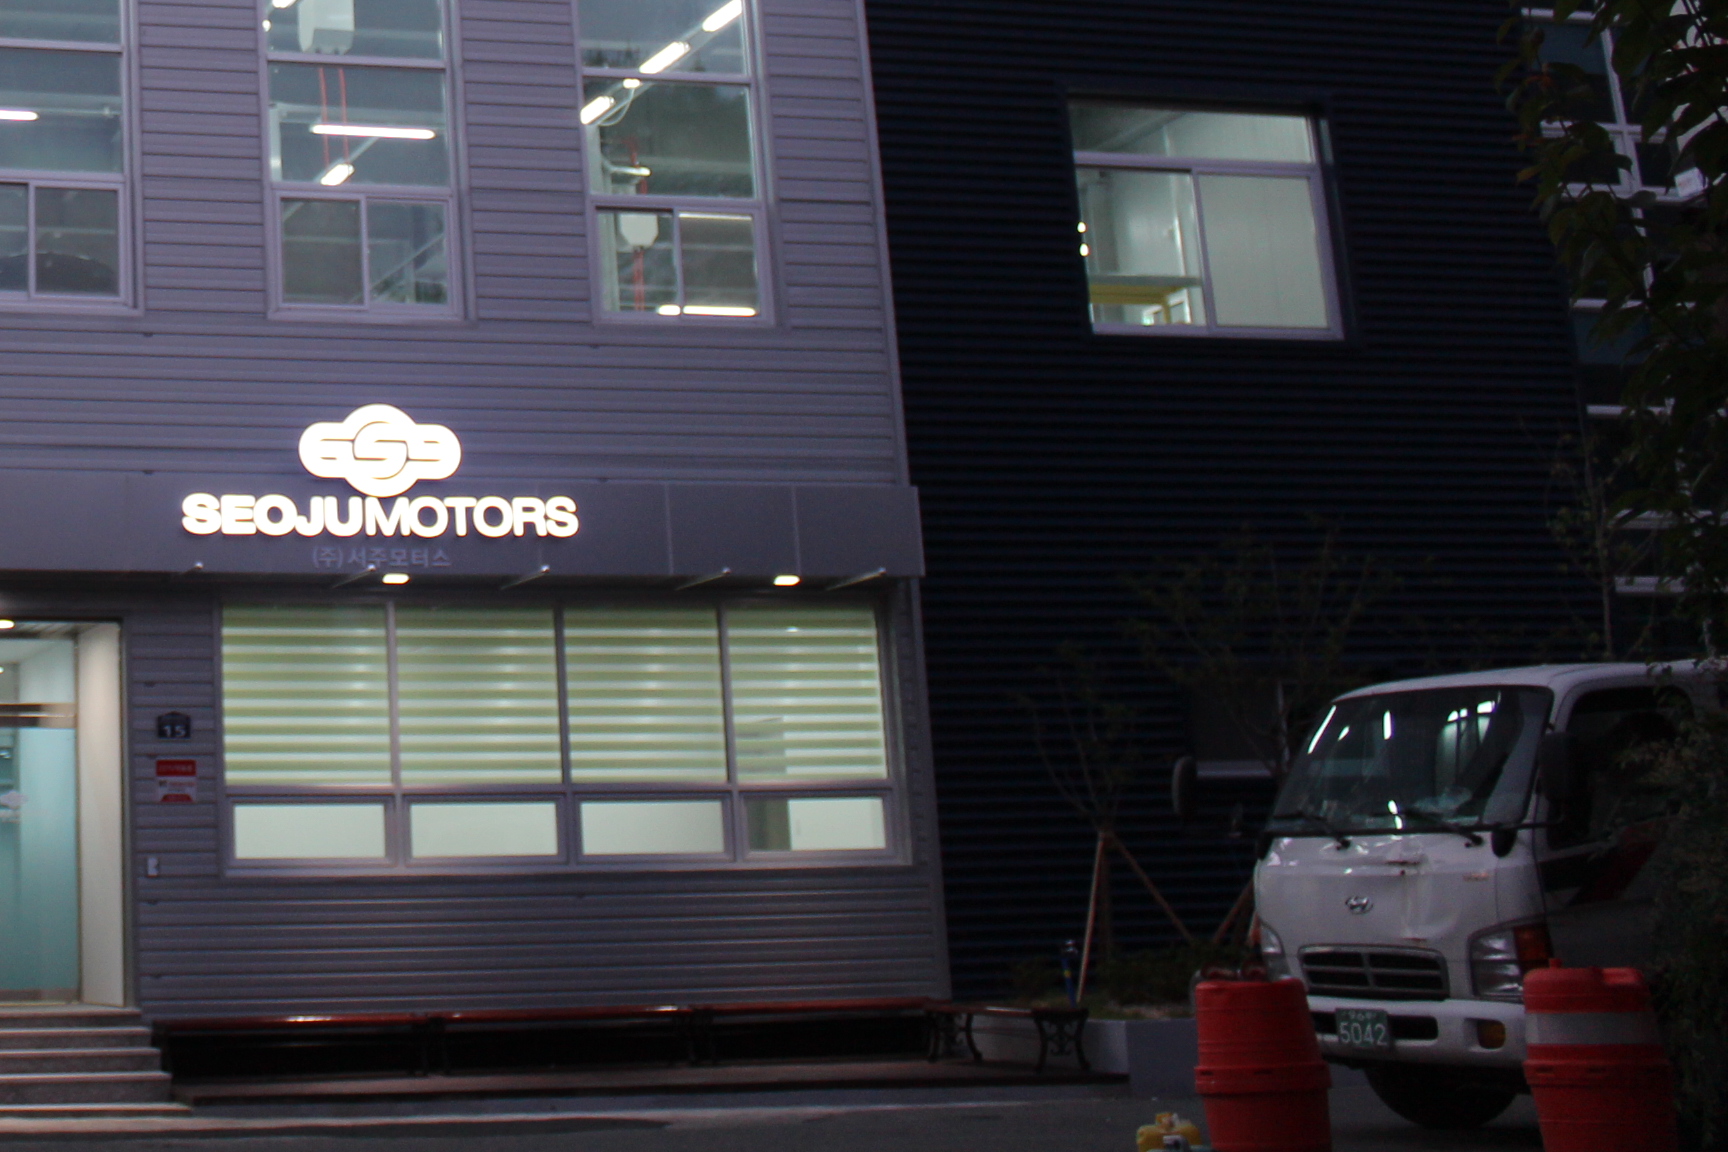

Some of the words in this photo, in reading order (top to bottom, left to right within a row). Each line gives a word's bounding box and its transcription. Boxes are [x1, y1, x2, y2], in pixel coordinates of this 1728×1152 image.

[181, 493, 580, 538] SEOJUMOTORS
[163, 724, 187, 737] 15
[1339, 1022, 1388, 1046] 5042
